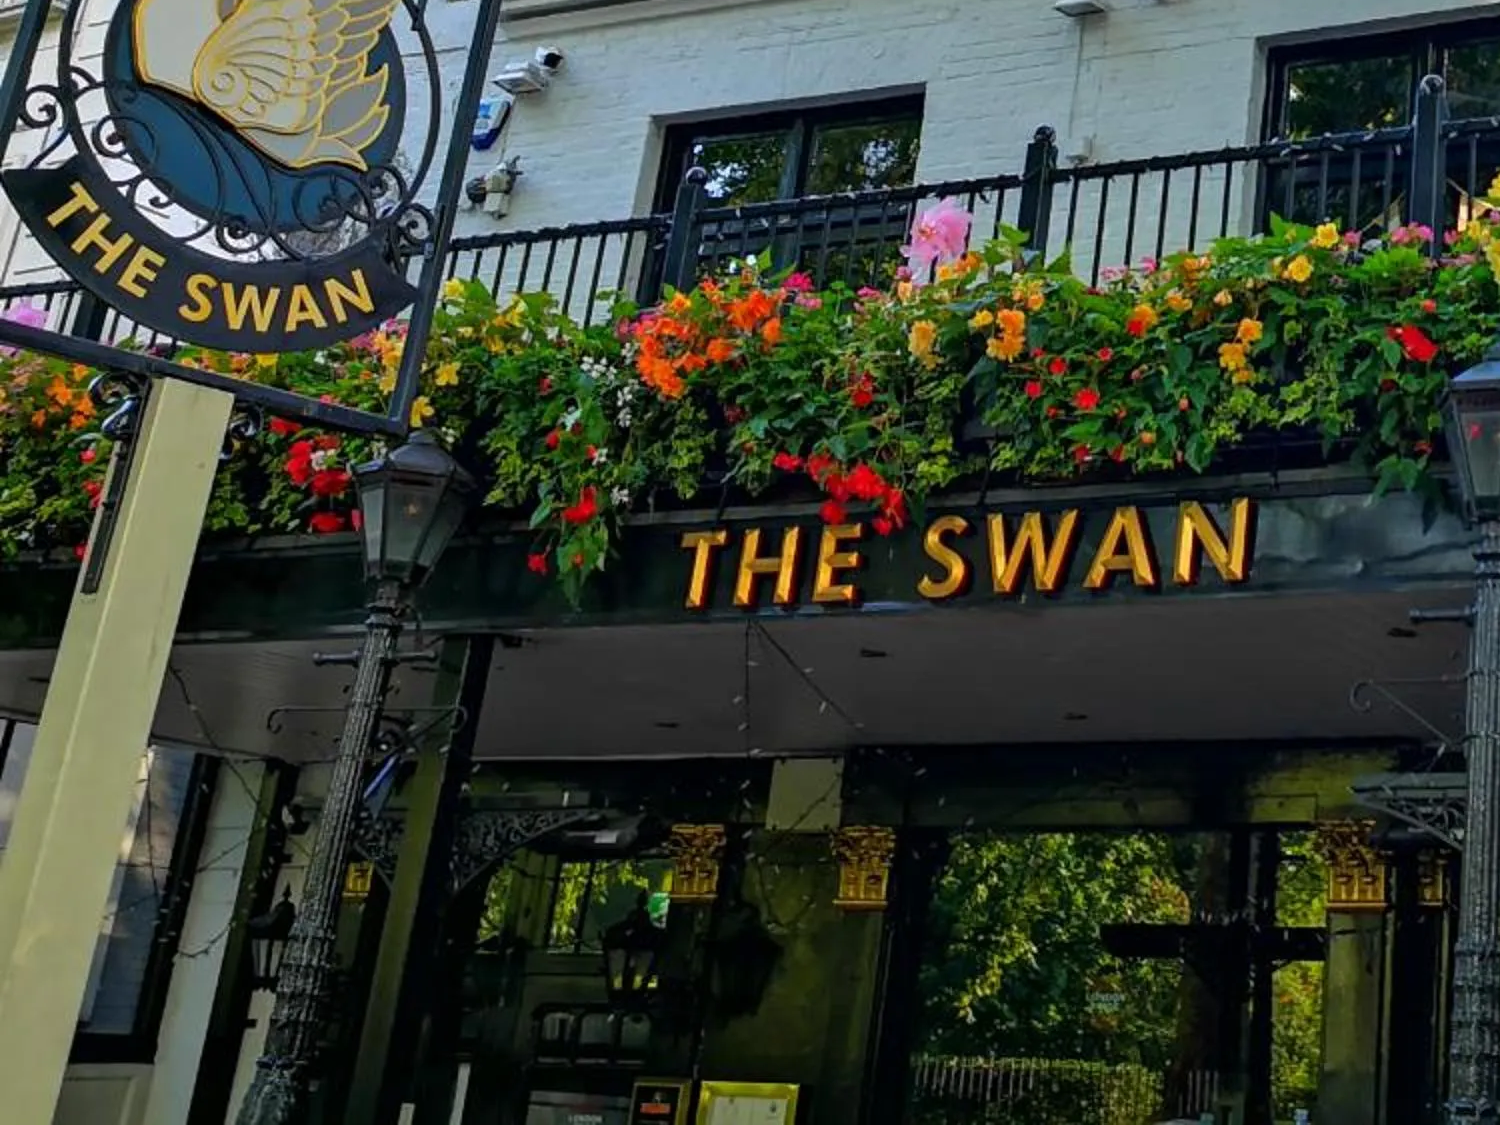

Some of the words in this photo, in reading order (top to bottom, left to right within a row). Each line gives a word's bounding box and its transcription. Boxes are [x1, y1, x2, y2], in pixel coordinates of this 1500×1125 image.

[47, 181, 166, 298] THE
[178, 269, 375, 332] SWAN
[681, 522, 865, 609] THE
[916, 498, 1257, 599] SWAN
